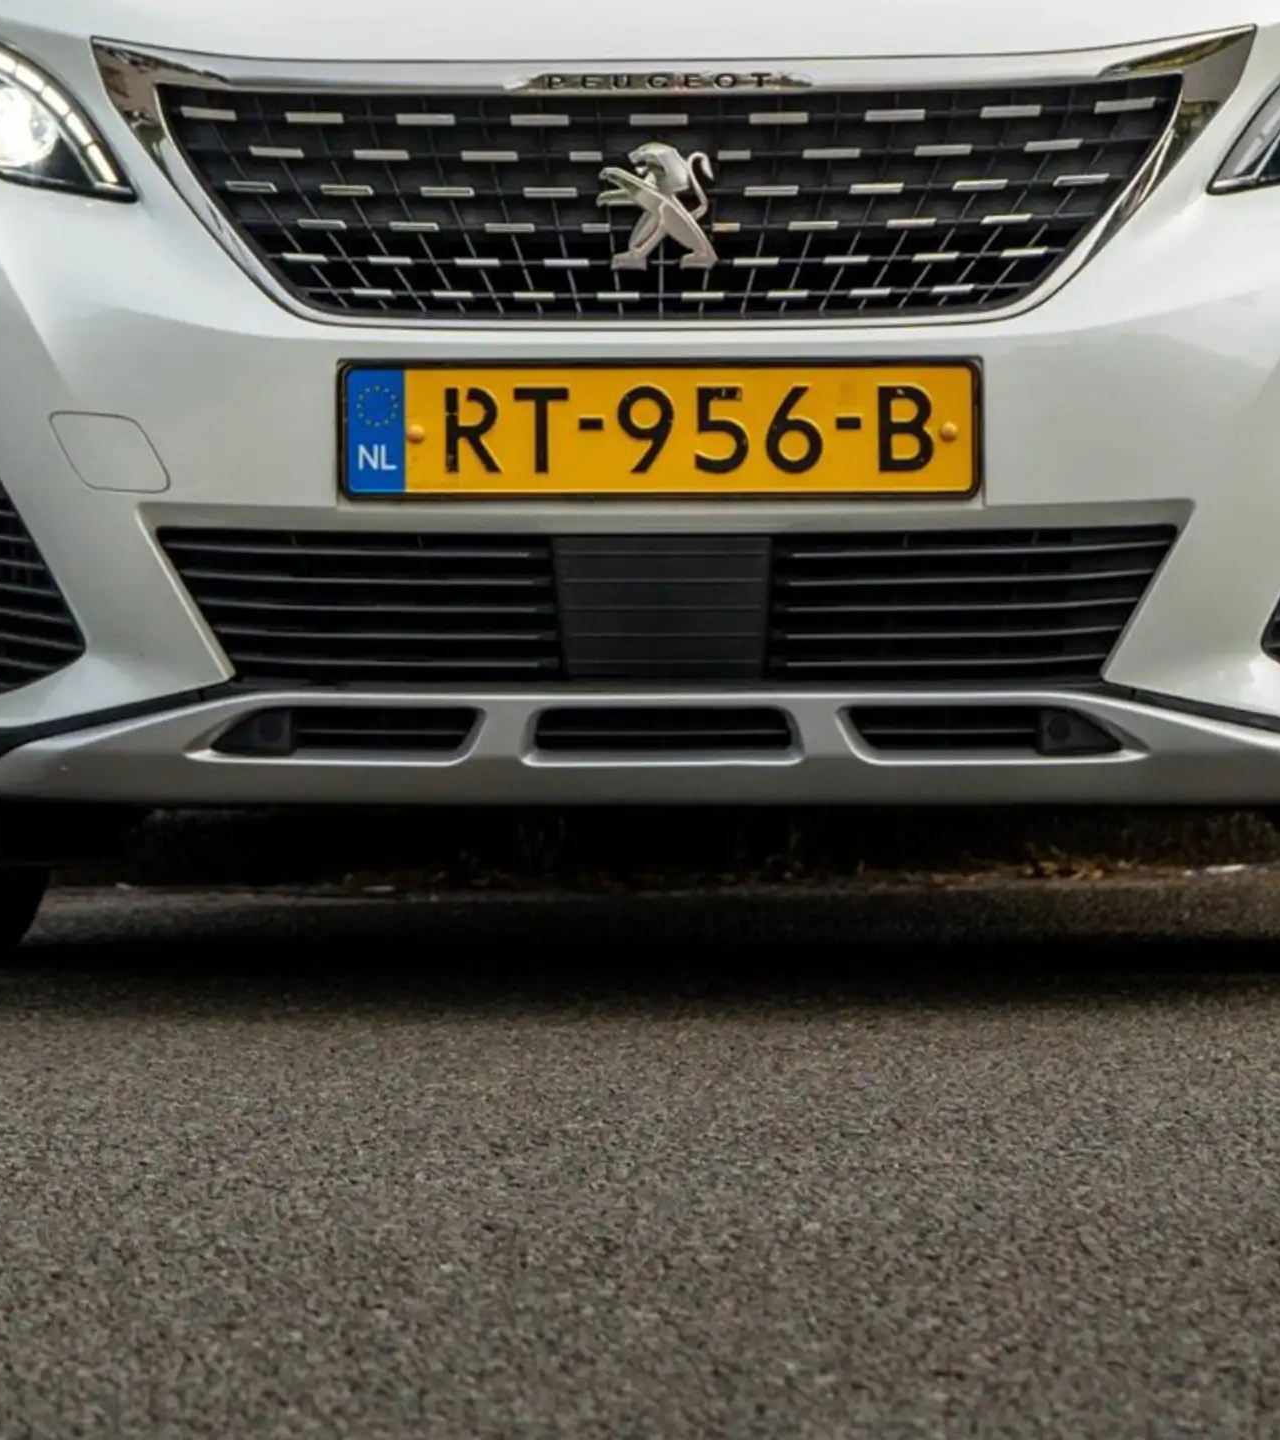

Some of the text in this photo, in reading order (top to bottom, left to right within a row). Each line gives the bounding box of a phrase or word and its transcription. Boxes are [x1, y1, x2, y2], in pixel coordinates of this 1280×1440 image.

[546, 72, 772, 89] PEUGEOT
[443, 385, 935, 474] RT-956-B
[358, 445, 397, 471] NL
